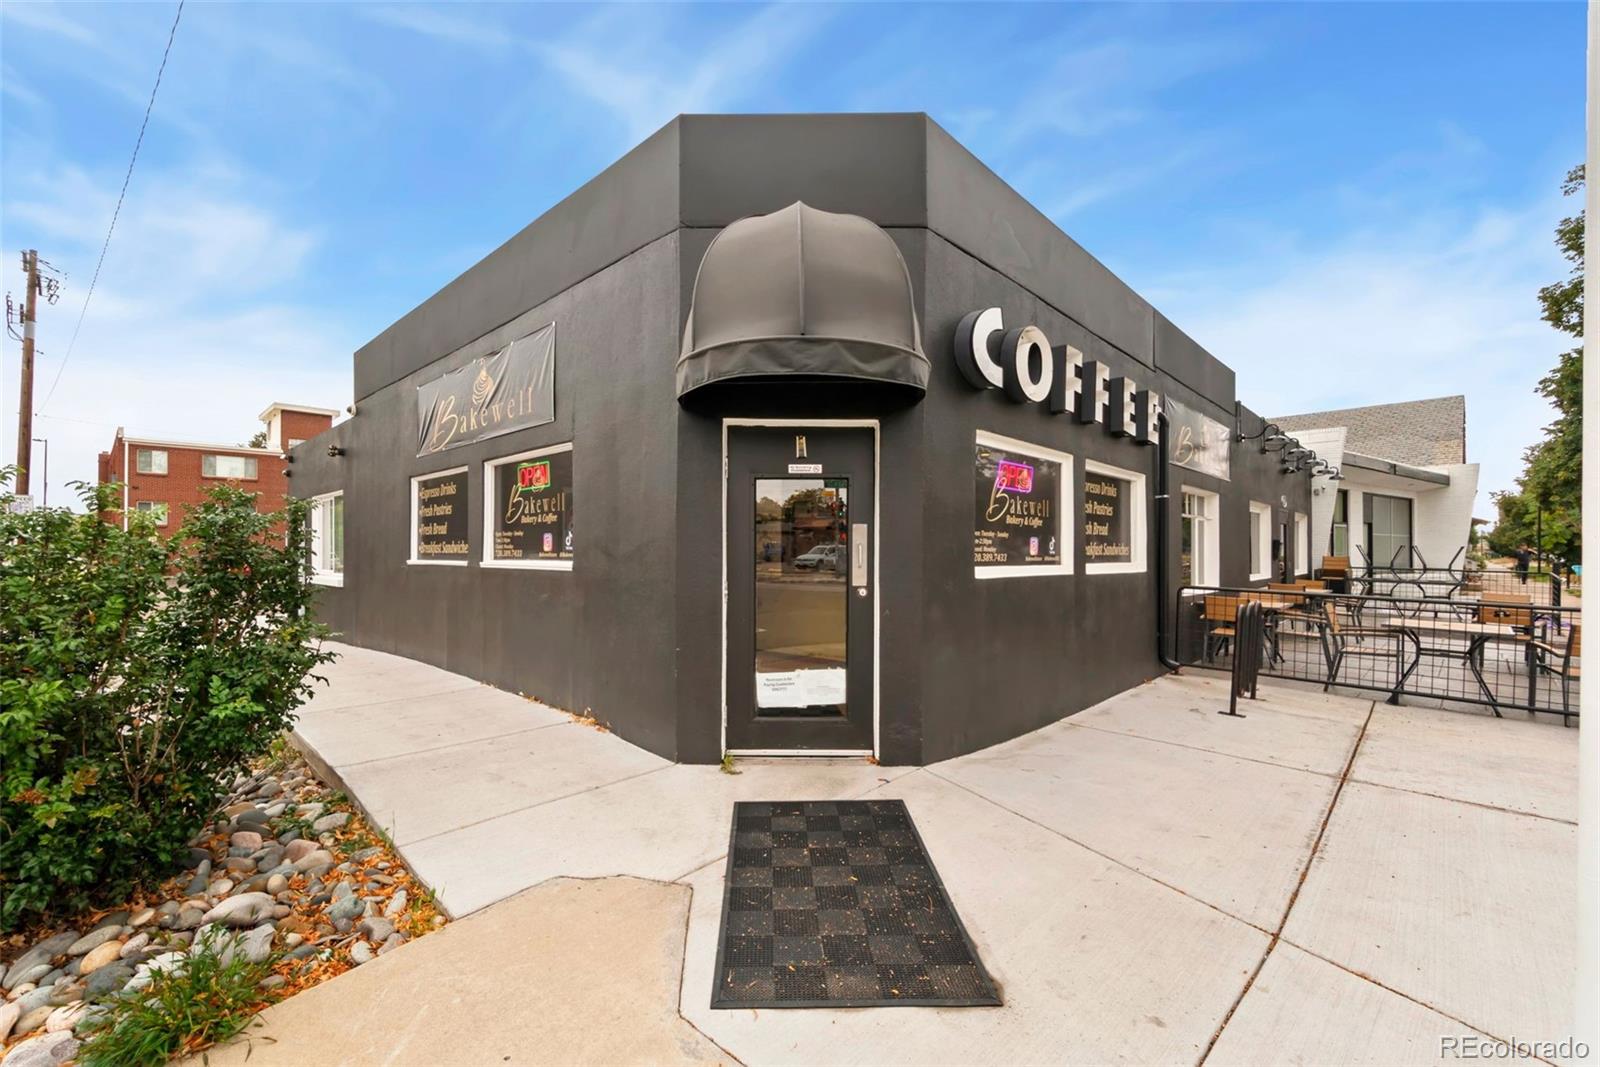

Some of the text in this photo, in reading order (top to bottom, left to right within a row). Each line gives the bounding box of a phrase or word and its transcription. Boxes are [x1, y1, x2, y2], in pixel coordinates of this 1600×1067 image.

[956, 307, 1160, 445] COFFEE
[430, 386, 533, 453] Bakewell
[520, 464, 548, 488] OPEN
[440, 482, 457, 496] Drinks
[1101, 482, 1117, 497] Drinks
[505, 483, 565, 524] Bakewell
[984, 476, 1050, 522] Bakewell
[433, 502, 453, 516] Pastries
[1093, 501, 1113, 516] Pastries
[521, 515, 537, 525] Bakery
[542, 512, 558, 524] Coffee
[1006, 514, 1024, 527] Bakery
[1028, 518, 1043, 528] Coffee
[433, 521, 448, 535] Bread
[1093, 521, 1109, 535] Bread
[1103, 542, 1129, 556] Sandwiches
